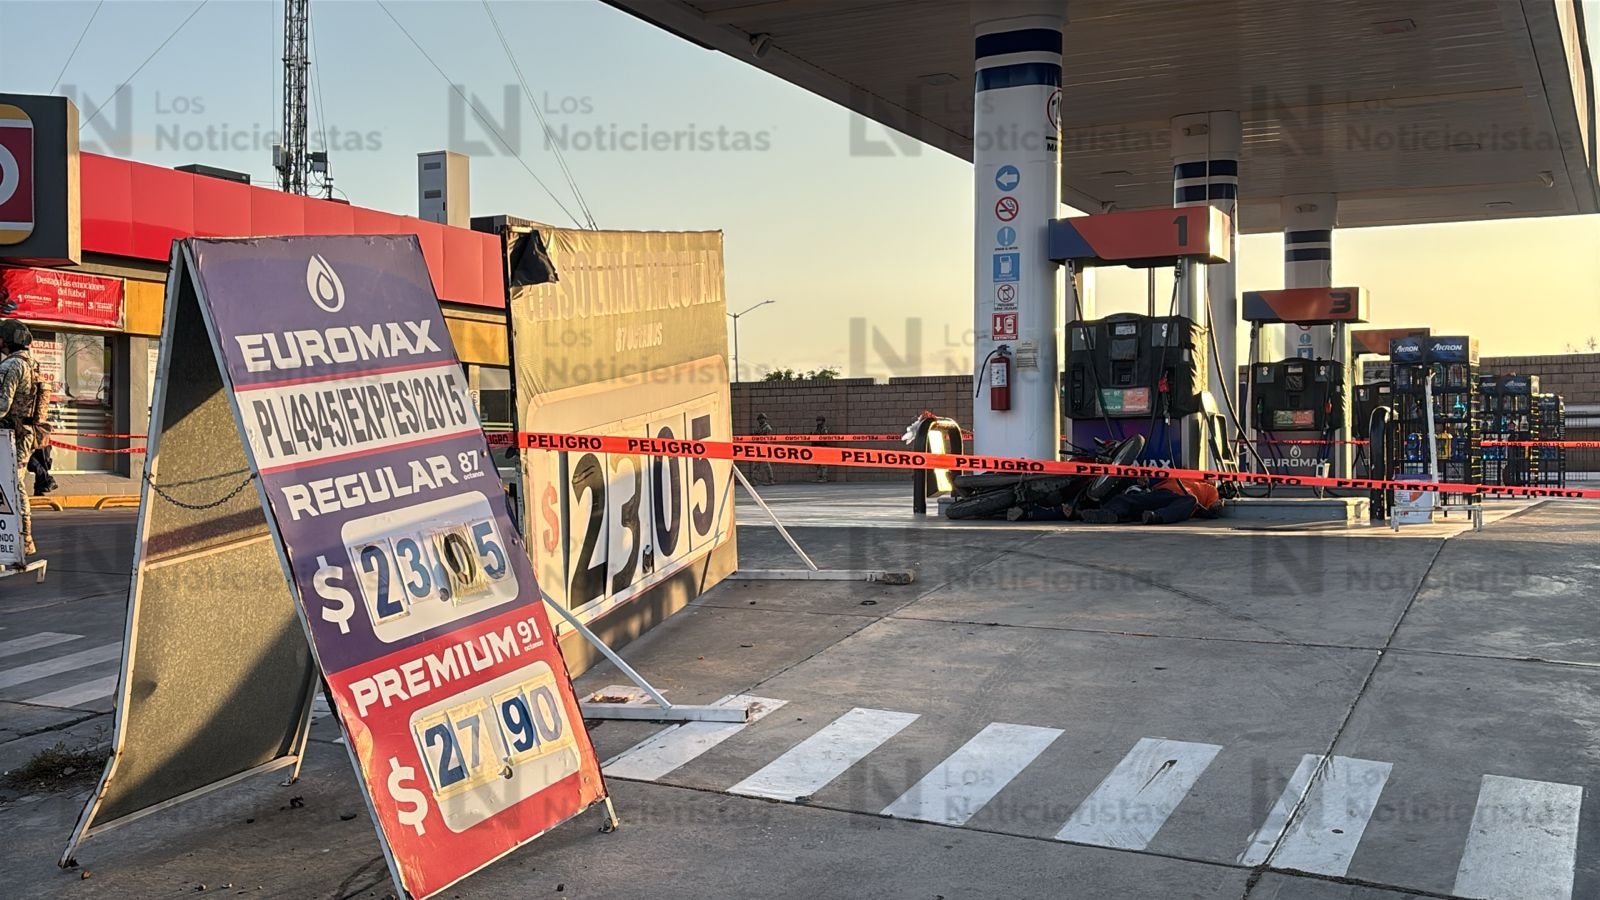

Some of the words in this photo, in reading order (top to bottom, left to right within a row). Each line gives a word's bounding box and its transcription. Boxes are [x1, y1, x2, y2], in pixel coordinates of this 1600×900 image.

[1173, 216, 1188, 247] 1
[1328, 292, 1351, 314] 3
[235, 319, 441, 373] EUROMAX
[1431, 343, 1463, 351] AKRON
[253, 374, 468, 459] PL/4945/EXP/ES/2015
[463, 470, 485, 481] octanos
[527, 434, 602, 450] PELIGRO
[628, 439, 706, 455] PELIGRO
[733, 445, 813, 461] PELIGRO
[841, 451, 926, 466] PELIGRO
[956, 457, 1045, 472] PELIGRO
[1076, 465, 1170, 478] PELIGRO
[281, 455, 458, 521] REGULAR
[457, 449, 479, 473] 87
[348, 625, 521, 718] PREMIUM
[516, 616, 541, 644] 91
